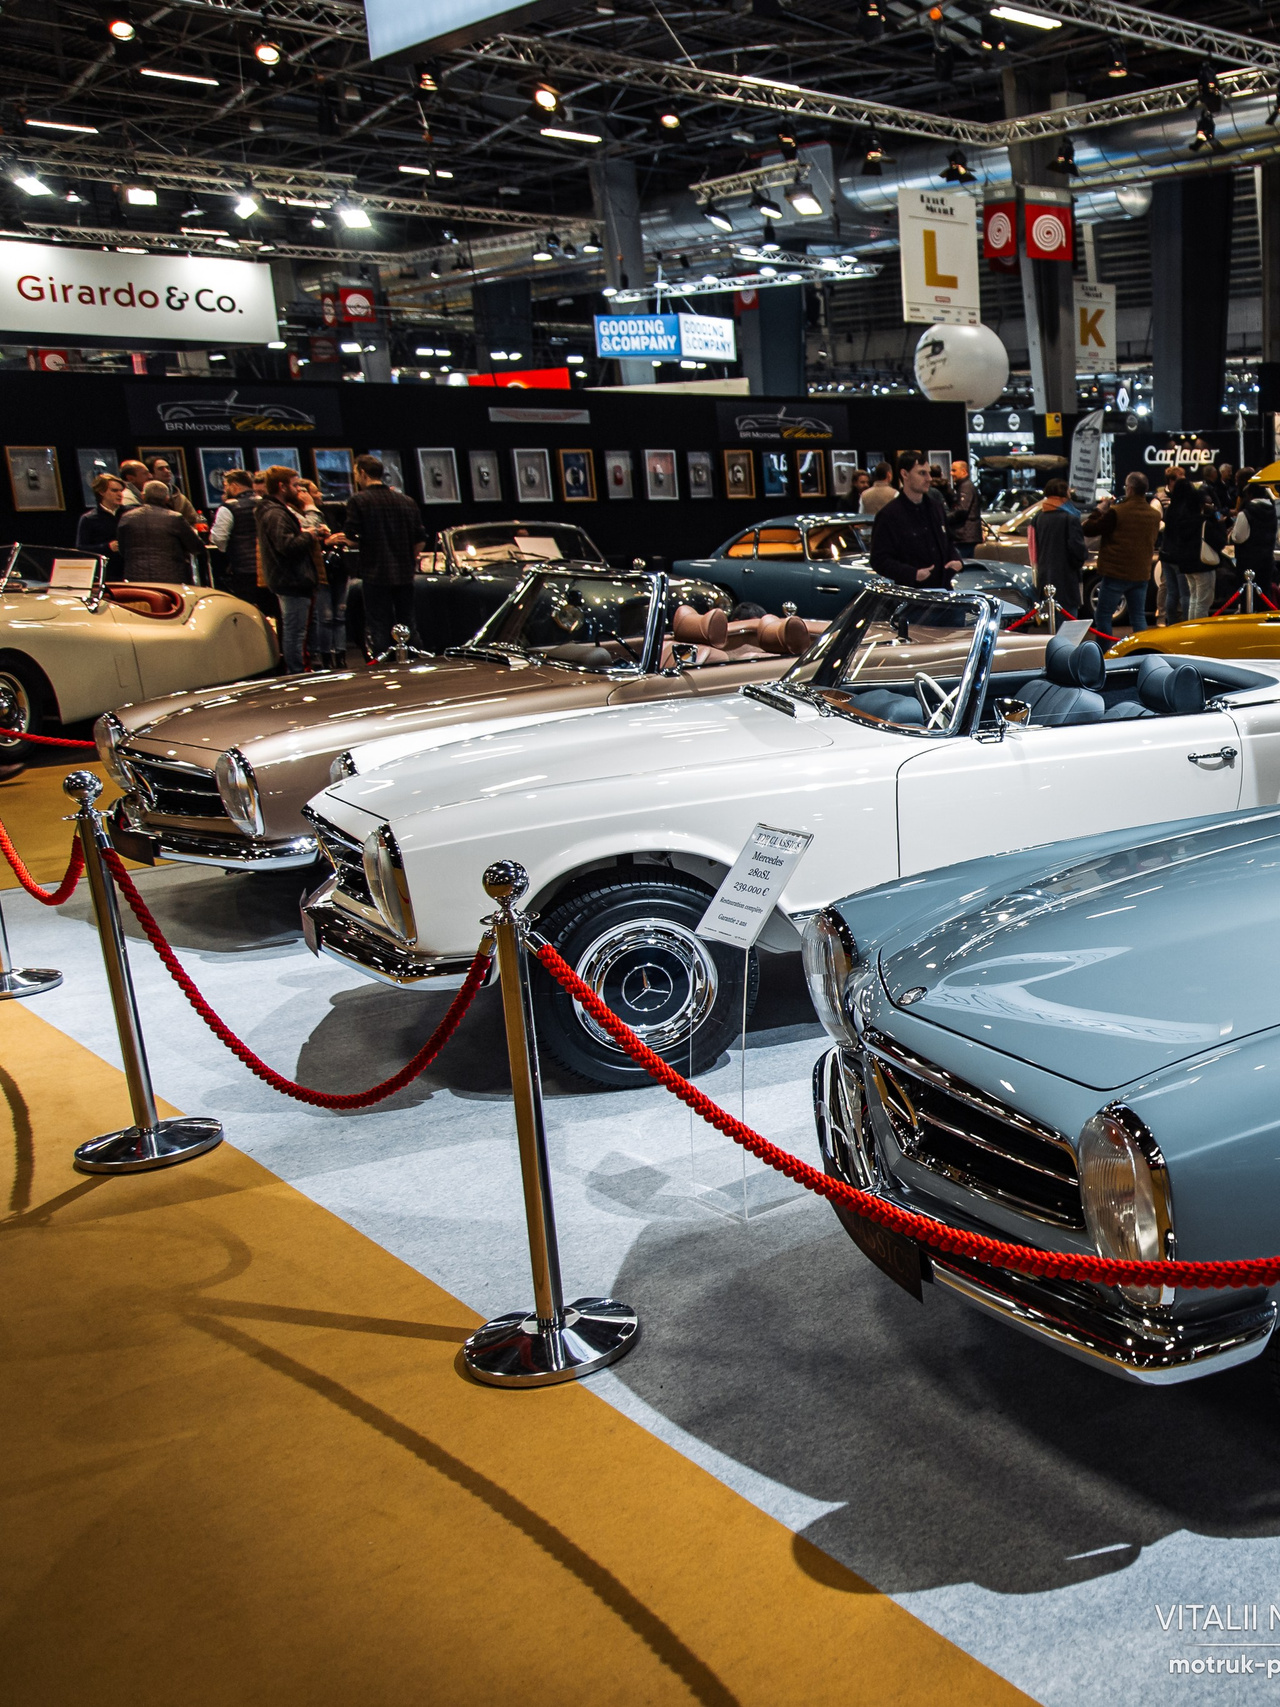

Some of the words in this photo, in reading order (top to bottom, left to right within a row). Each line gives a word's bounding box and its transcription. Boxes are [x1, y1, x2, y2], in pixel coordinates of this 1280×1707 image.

[922, 229, 959, 290] L
[17, 275, 160, 309] Girardo
[164, 286, 189, 311] &
[195, 288, 244, 314] Co.
[599, 319, 665, 336] GOODING
[683, 320, 725, 338] GOODING
[1079, 306, 1106, 348] K
[601, 335, 677, 352] &COMPANY
[1144, 444, 1220, 472] CarJager
[752, 851, 785, 867] Mercedes
[748, 868, 771, 880] 280SL
[734, 882, 762, 895] 239.000
[762, 887, 770, 897] €
[720, 897, 745, 909] Restauration
